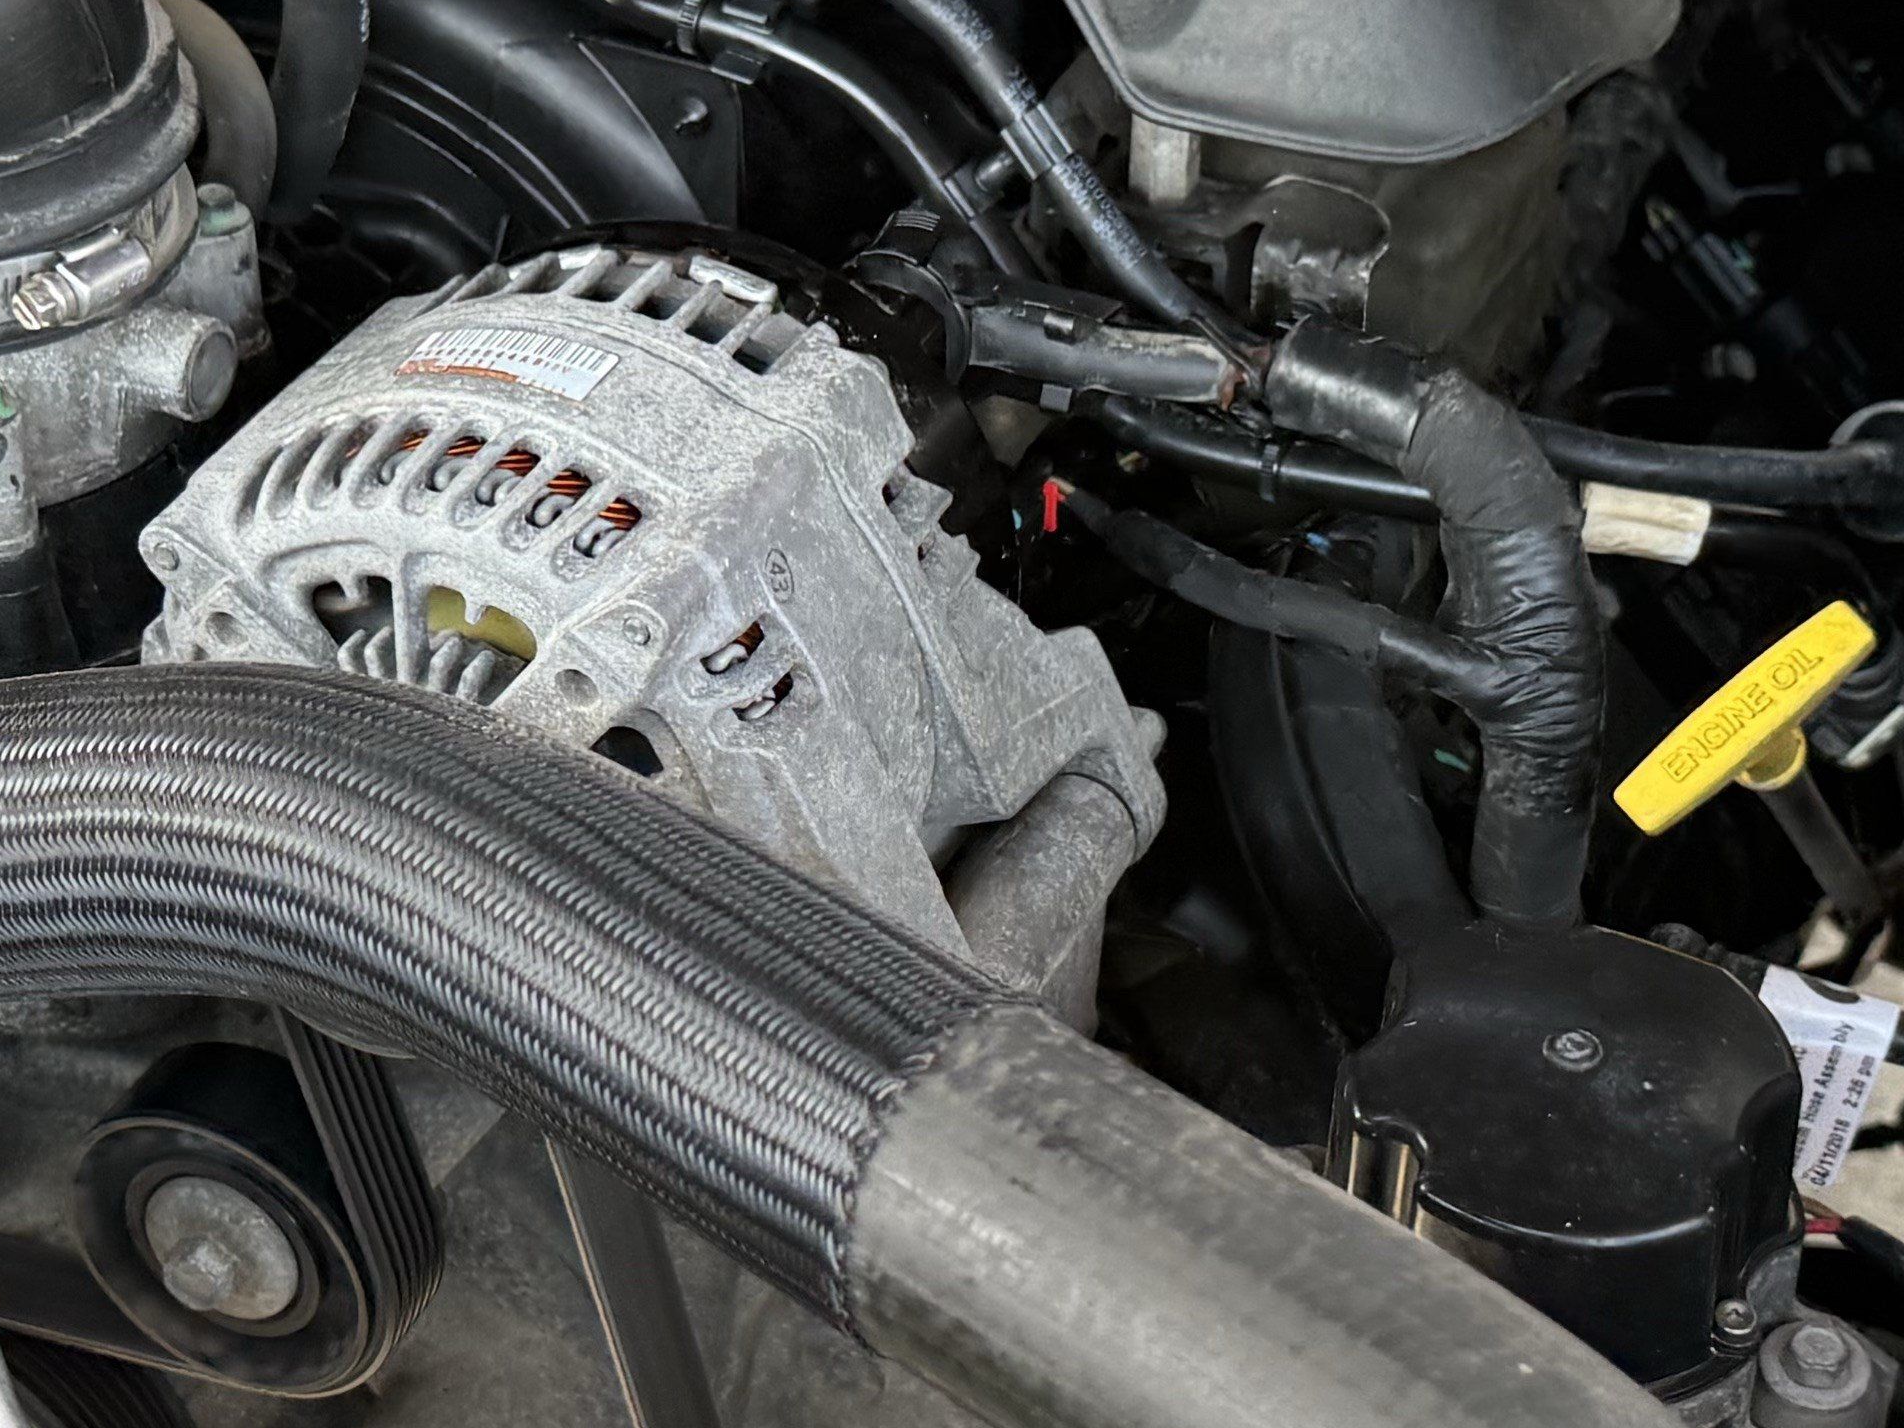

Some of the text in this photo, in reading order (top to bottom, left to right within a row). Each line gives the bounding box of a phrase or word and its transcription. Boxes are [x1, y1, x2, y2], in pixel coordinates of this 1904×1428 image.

[769, 562, 788, 592] 43
[1661, 646, 1823, 782] ENGINE OIL
[1802, 1091, 1825, 1123] Hose
[1814, 1021, 1854, 1088] Assembly
